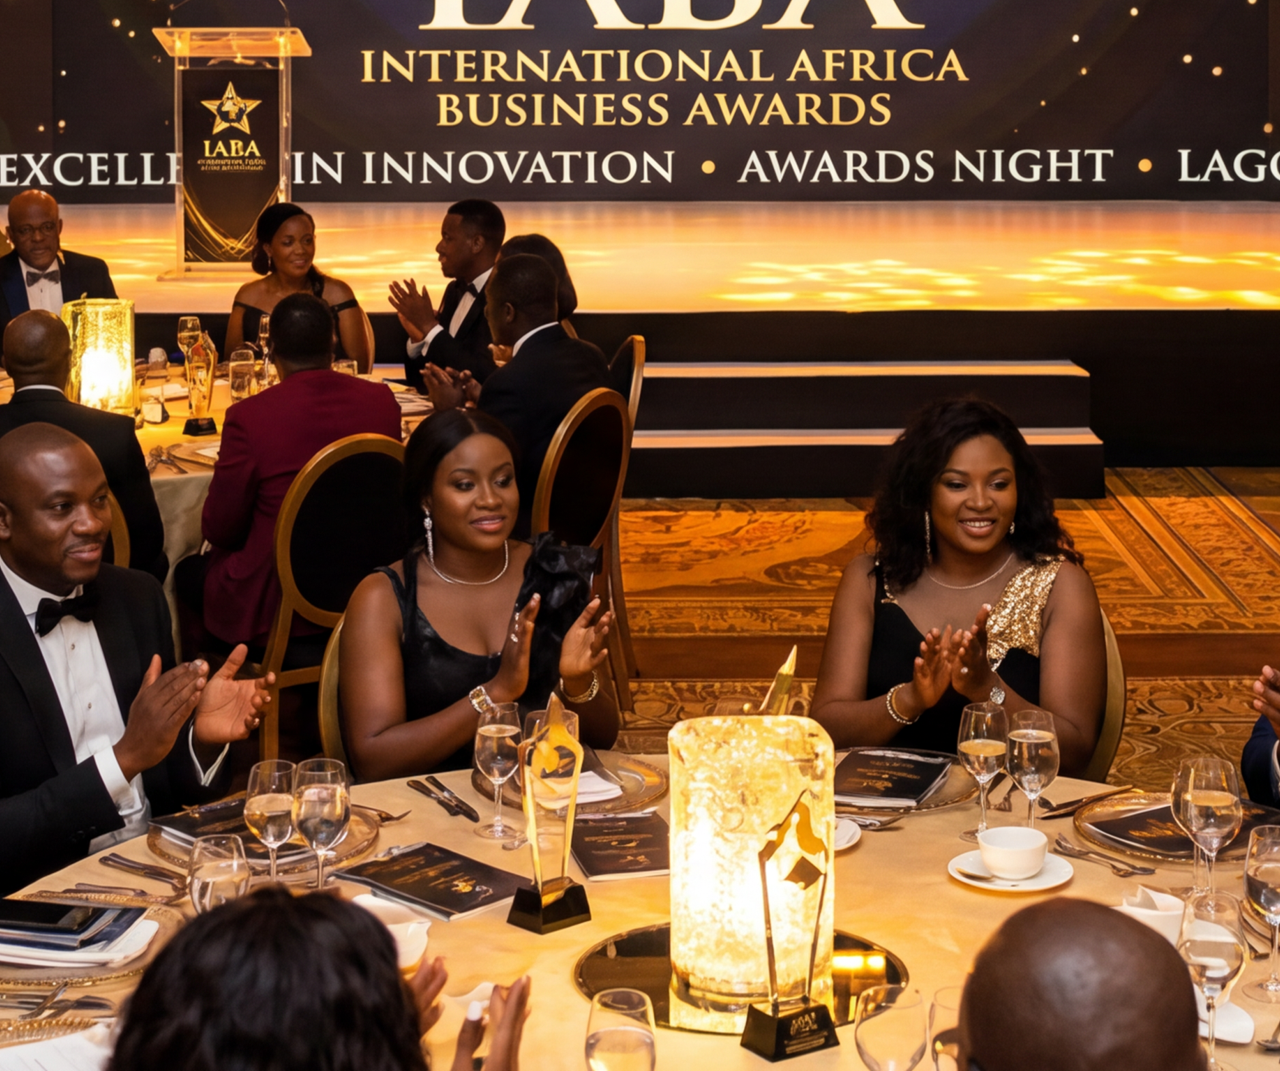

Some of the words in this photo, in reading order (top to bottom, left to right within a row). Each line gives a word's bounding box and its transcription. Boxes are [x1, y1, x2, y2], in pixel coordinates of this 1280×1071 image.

[360, 48, 775, 83] INTERNATIONAL
[786, 48, 970, 83] AFRICA
[436, 92, 669, 127] BUSINESS
[683, 92, 892, 127] AWARDS
[291, 151, 345, 184] IN
[363, 150, 675, 184] INNOVATION
[737, 149, 935, 183] AWARDS
[952, 149, 1114, 183] NIGHT
